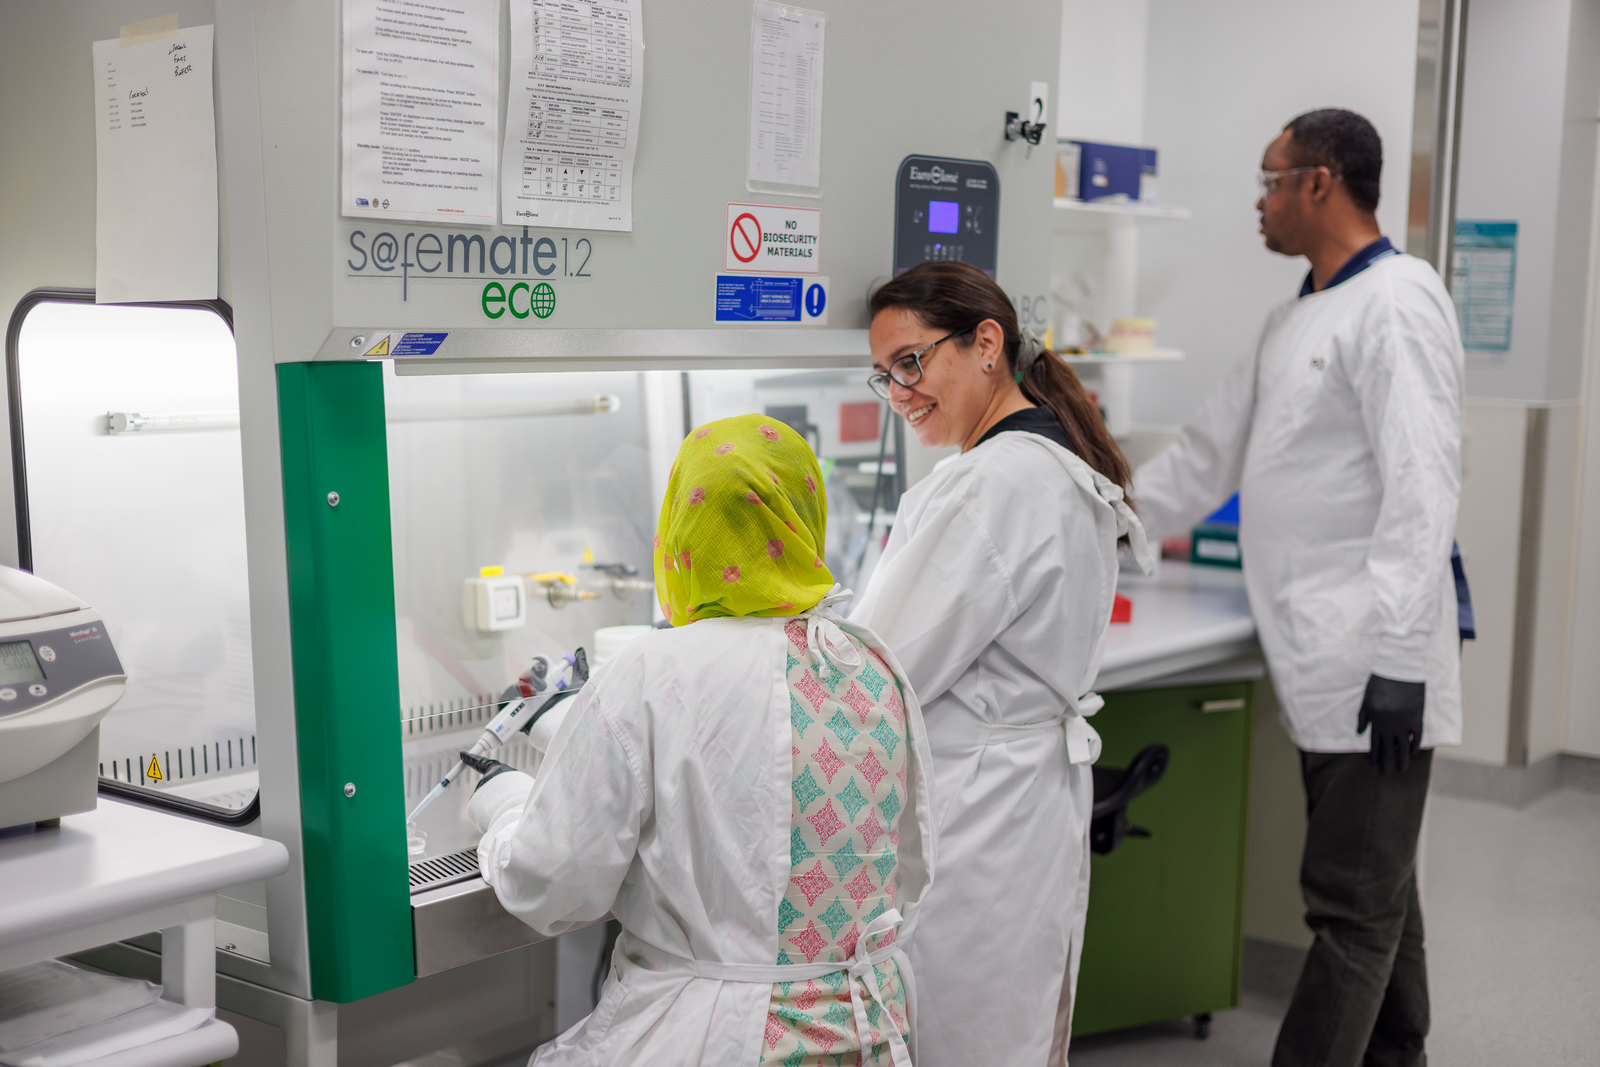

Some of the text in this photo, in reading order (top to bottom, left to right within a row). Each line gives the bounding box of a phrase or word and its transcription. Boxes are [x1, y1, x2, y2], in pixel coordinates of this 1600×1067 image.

[785, 220, 797, 230] NO
[763, 232, 817, 244] BIOSECURITY
[767, 247, 813, 258] MATERIALS
